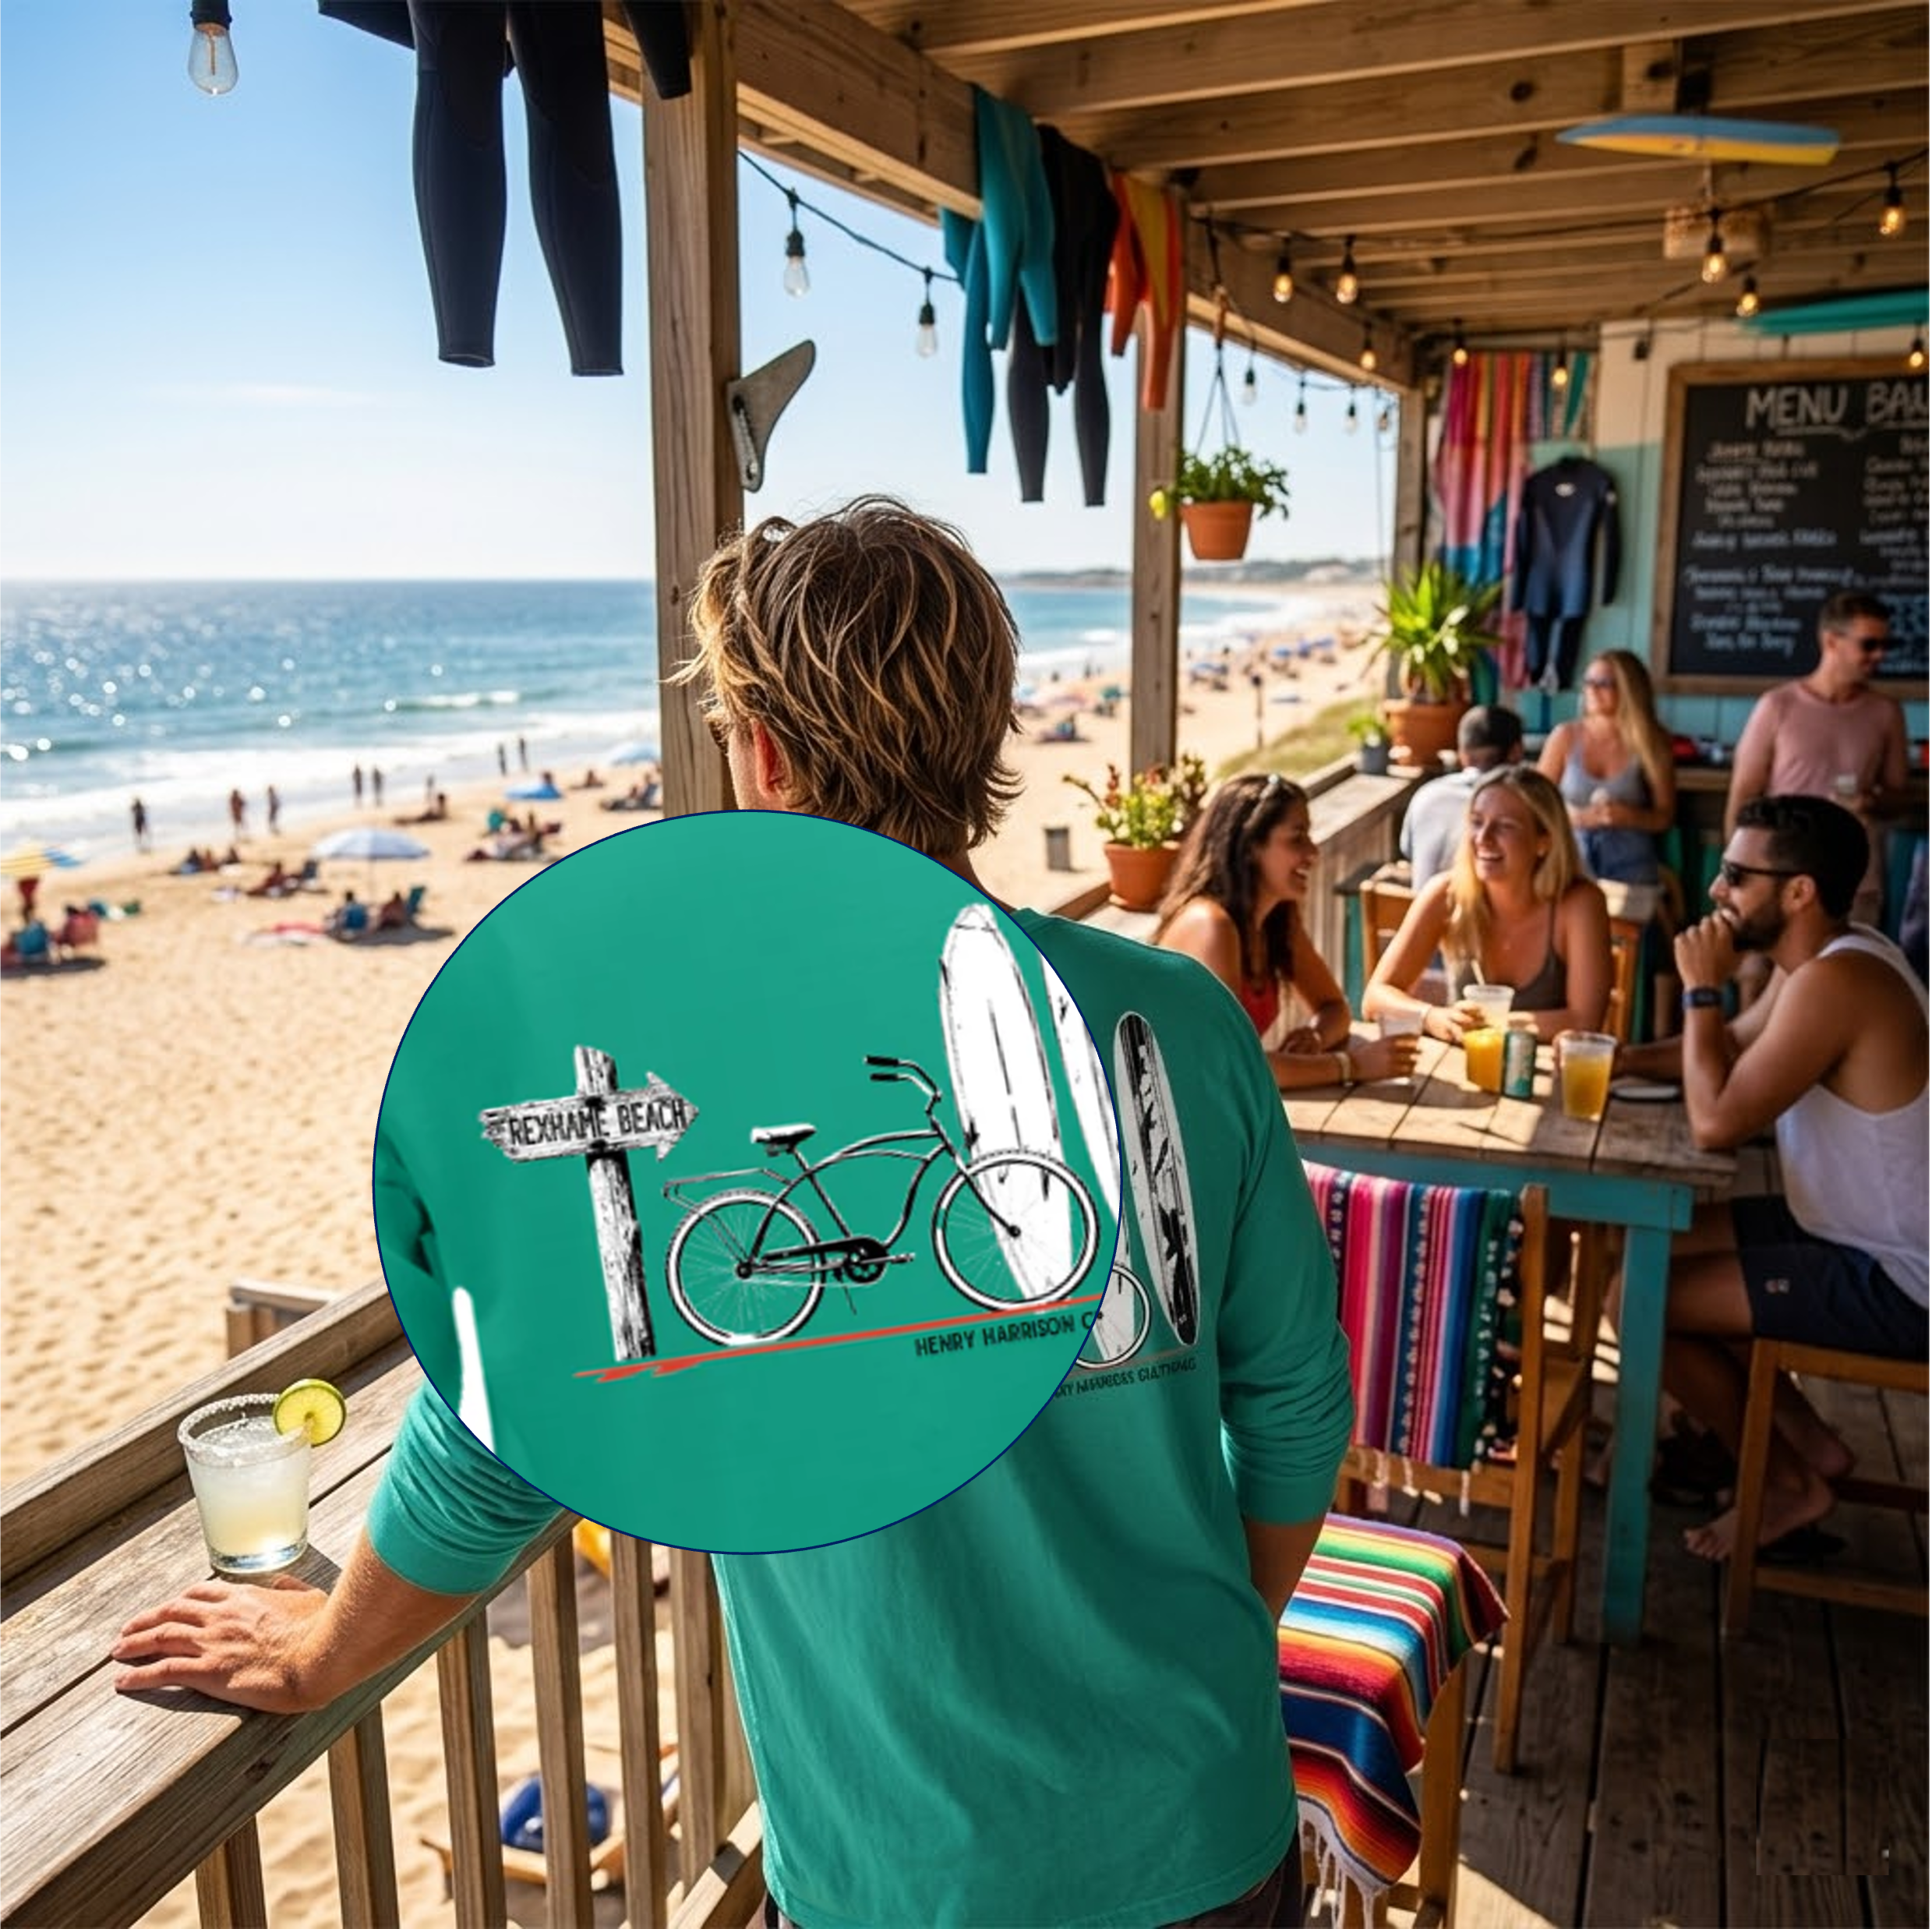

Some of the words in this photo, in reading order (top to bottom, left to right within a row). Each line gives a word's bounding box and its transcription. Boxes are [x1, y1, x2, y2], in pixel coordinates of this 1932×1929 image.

[1745, 387, 1848, 427] MENU
[509, 1107, 609, 1145] REXHAME
[617, 1098, 687, 1135] BEACH
[914, 1330, 975, 1356] HENRY
[982, 1315, 1075, 1346] HARRISON
